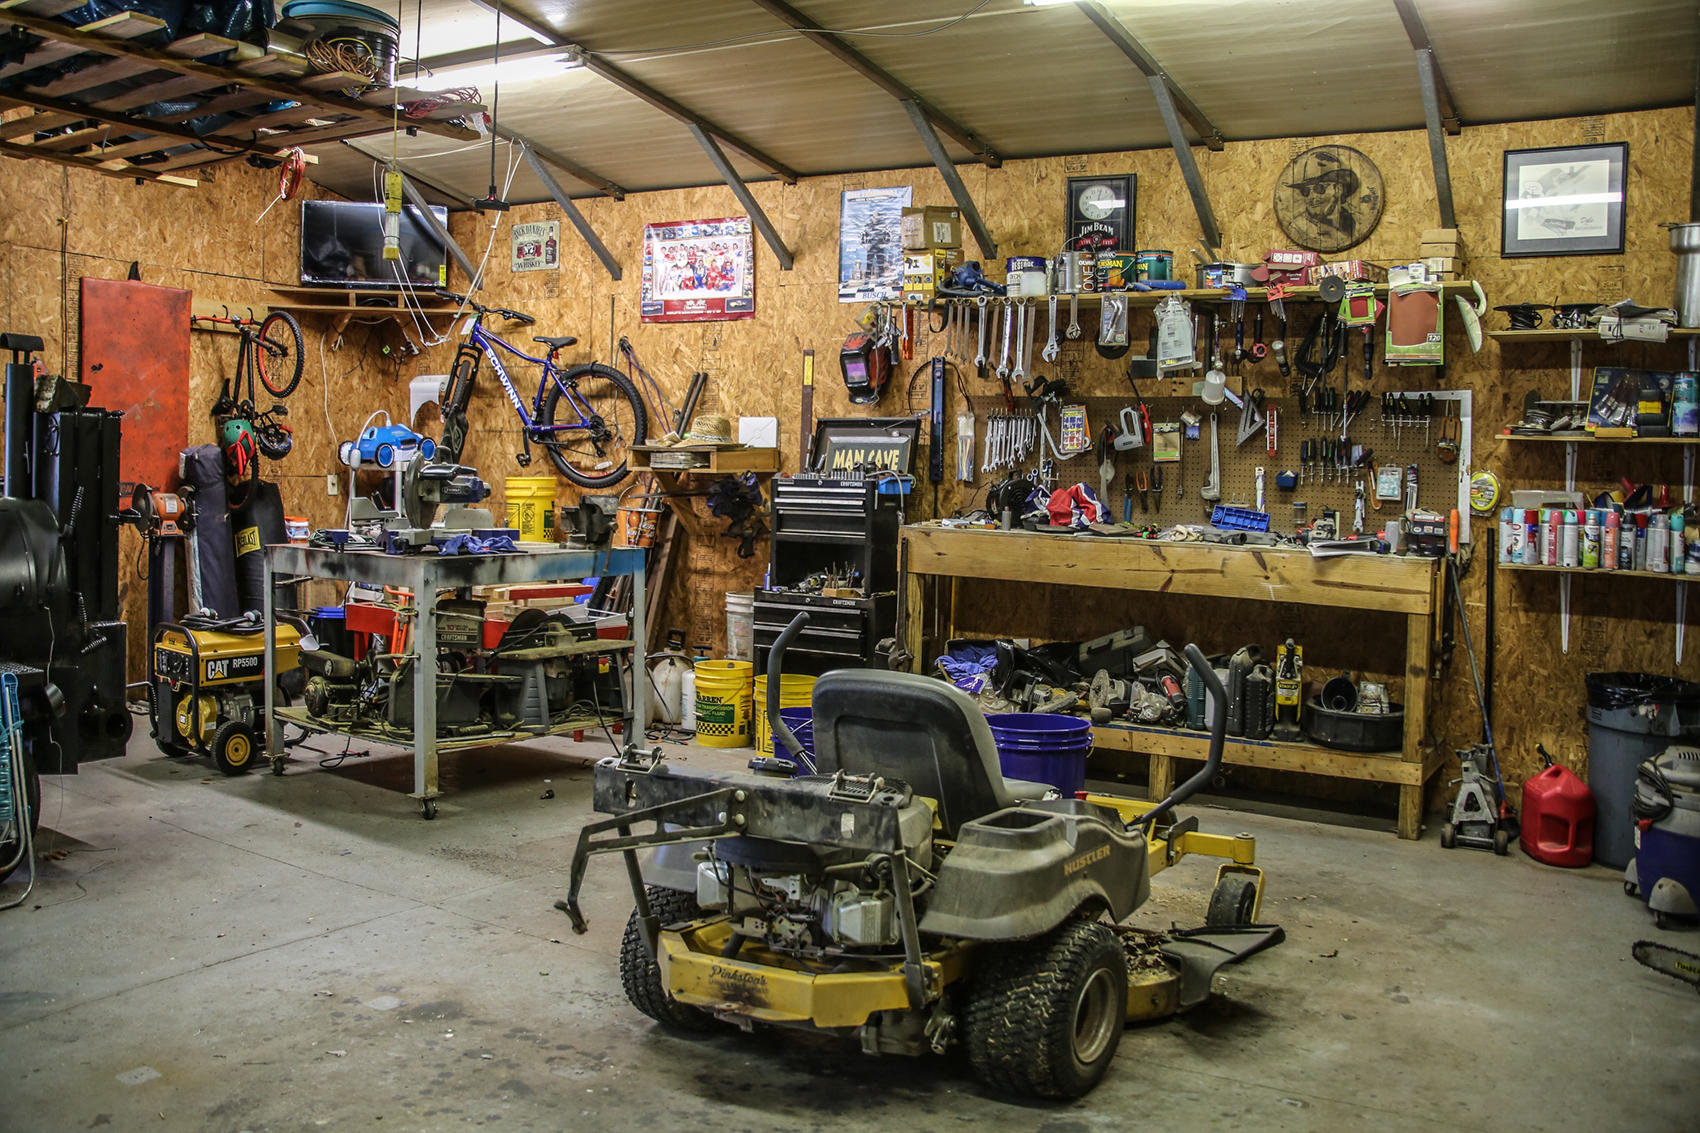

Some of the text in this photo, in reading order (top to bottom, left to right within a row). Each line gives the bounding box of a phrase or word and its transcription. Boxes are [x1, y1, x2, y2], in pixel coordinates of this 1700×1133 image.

[1080, 222, 1114, 237] JIM BEAM
[863, 291, 887, 299] BUSCH
[485, 348, 522, 409] SCHWINN
[832, 449, 899, 472] MAN CAVE
[207, 659, 230, 680] CAT
[232, 656, 259, 669] RP5500
[1064, 844, 1111, 877] HUSTLER
